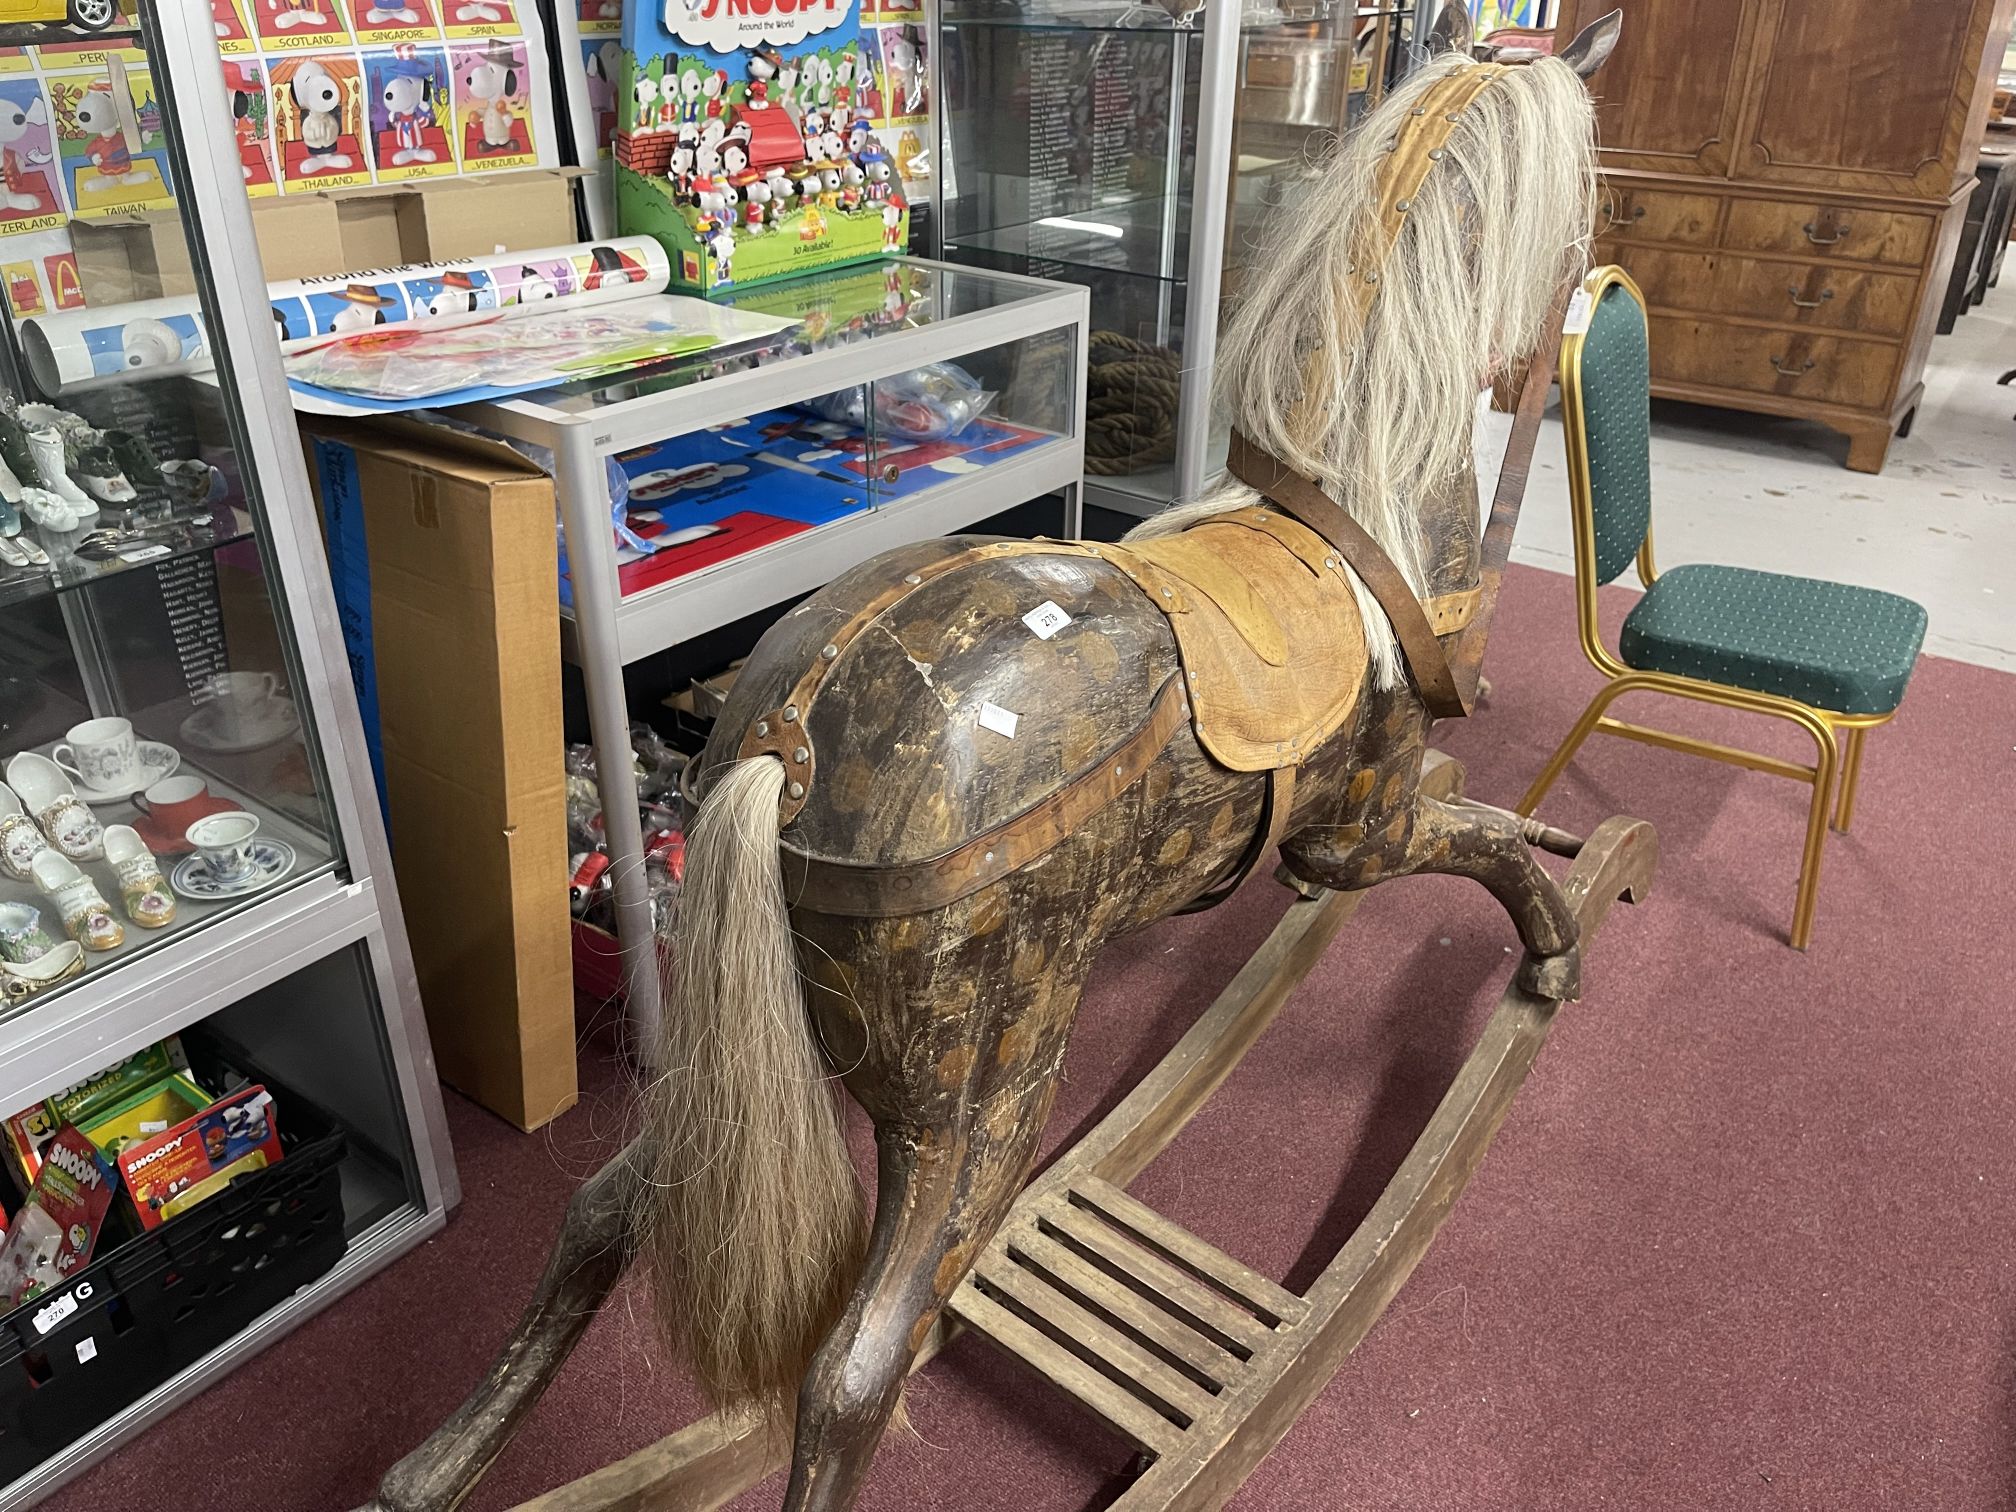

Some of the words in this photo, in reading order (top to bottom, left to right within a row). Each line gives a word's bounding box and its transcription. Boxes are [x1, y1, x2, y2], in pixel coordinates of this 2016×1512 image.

[738, 22, 763, 31] Around
[764, 22, 775, 30] the
[776, 20, 795, 29] World
[300, 269, 376, 285] Around
[1040, 613, 1058, 627] 278
[58, 1072, 122, 1112] MOTORIZED
[50, 1143, 102, 1191] SNOOPY
[127, 1136, 184, 1174] SNOOPY
